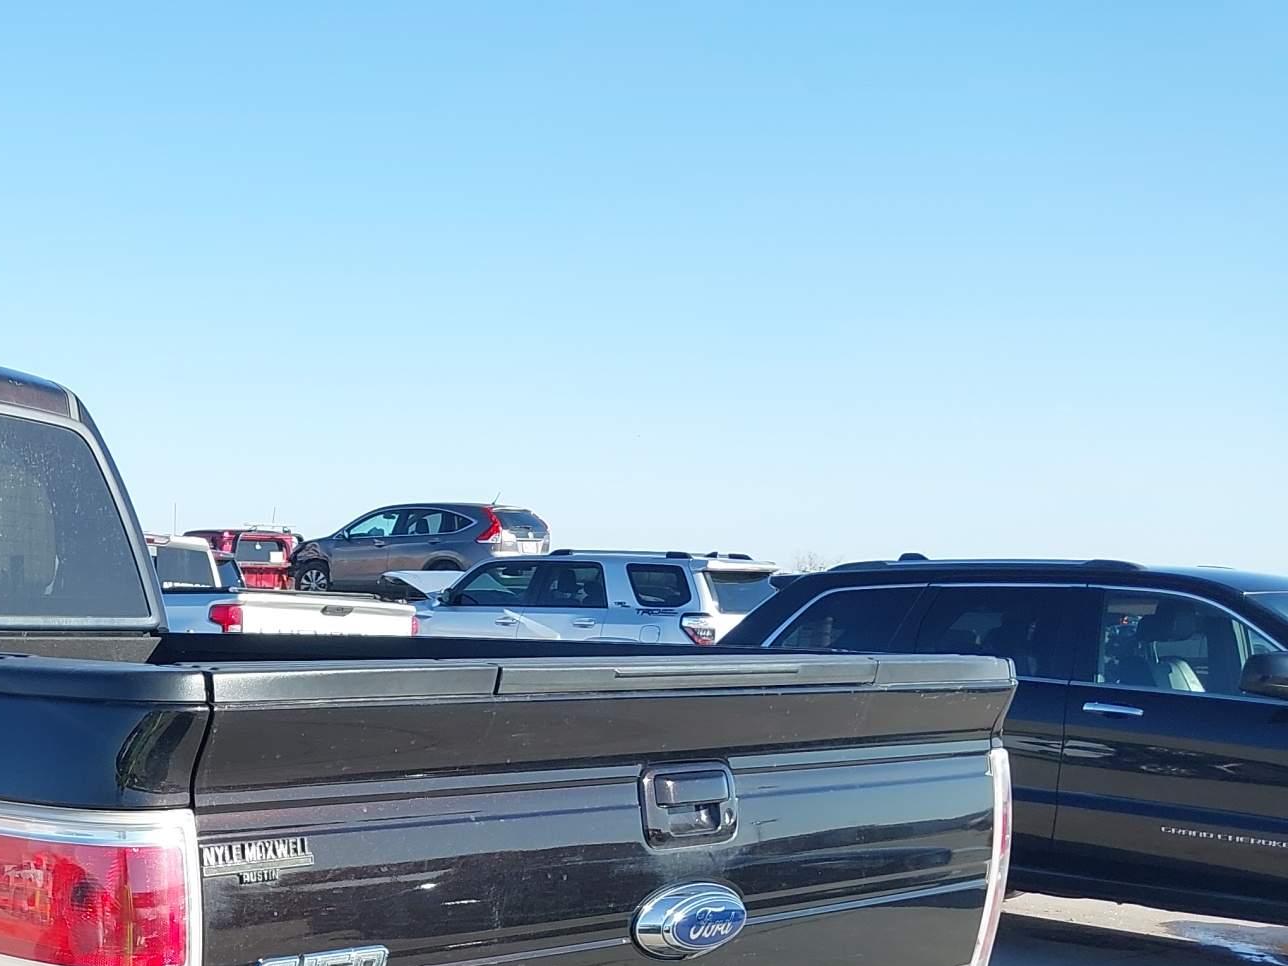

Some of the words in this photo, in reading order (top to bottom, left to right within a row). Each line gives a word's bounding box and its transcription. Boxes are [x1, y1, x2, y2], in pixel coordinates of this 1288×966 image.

[1160, 826, 1214, 838] GRAND
[202, 843, 242, 867] NYLE
[244, 837, 313, 863] MAXWELL
[243, 868, 280, 884] AUSTIN
[689, 906, 735, 940] Ford
